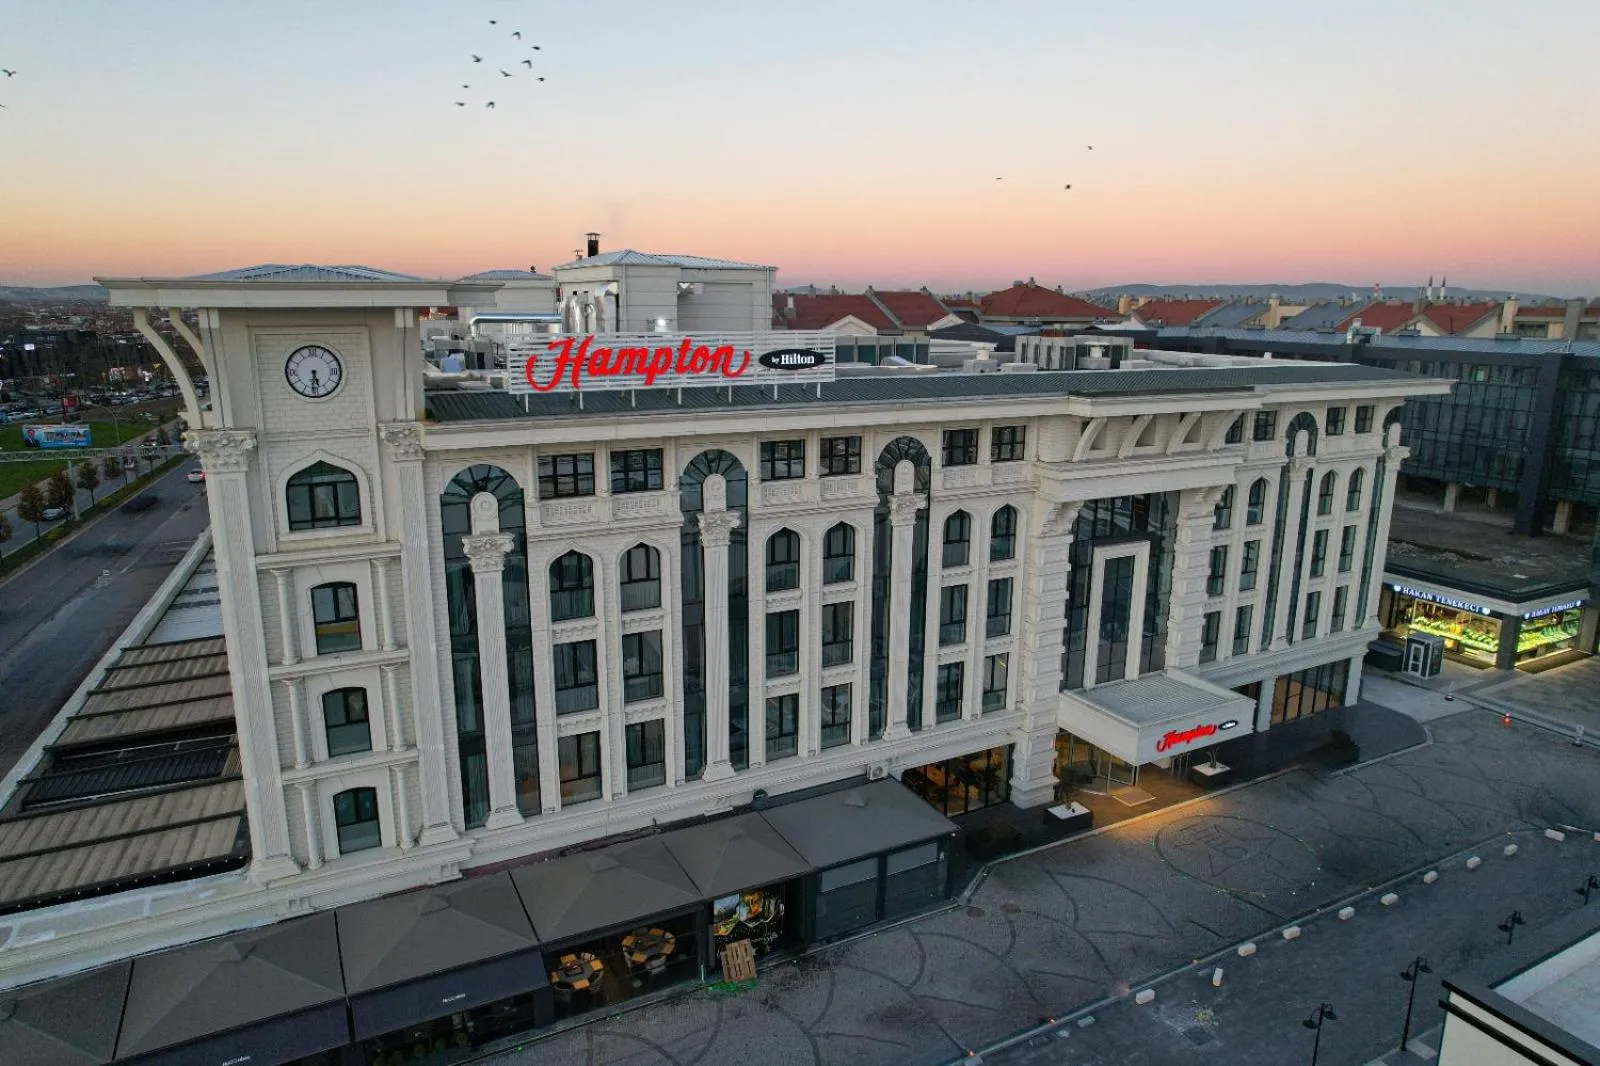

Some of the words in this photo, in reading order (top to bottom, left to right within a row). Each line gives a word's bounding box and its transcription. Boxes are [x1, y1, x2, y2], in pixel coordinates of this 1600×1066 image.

[526, 335, 750, 392] Hampton
[781, 353, 815, 365] Hilton
[1402, 587, 1433, 600] HAKAN
